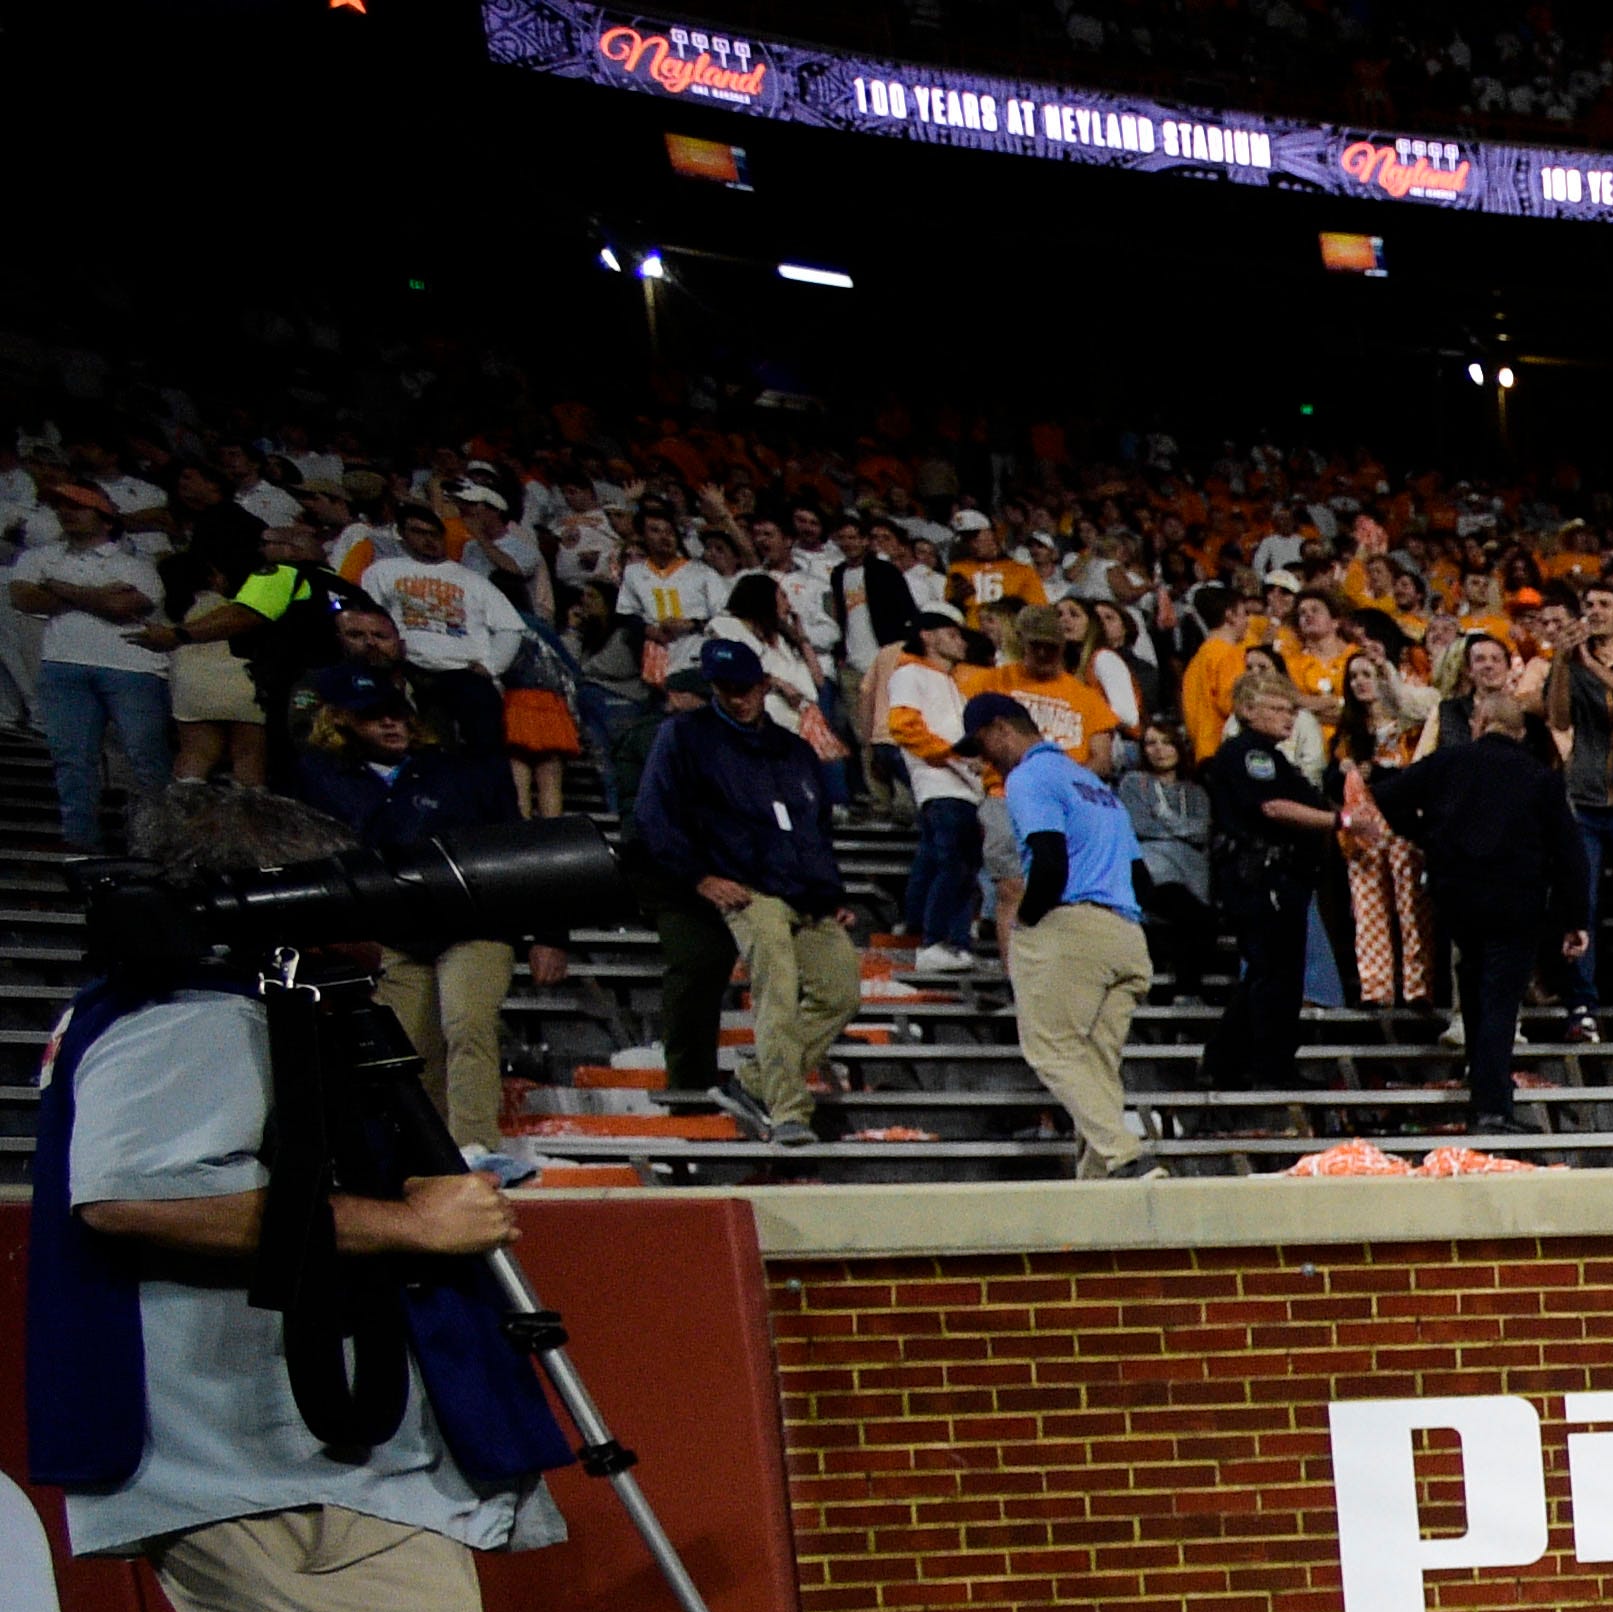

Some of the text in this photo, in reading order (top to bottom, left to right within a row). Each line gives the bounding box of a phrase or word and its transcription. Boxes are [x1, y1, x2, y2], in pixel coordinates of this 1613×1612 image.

[600, 26, 766, 93] Neyland
[854, 77, 1272, 168] 100 YEARS AT NEYLAND STADIUM
[1541, 167, 1581, 202] 100
[653, 588, 684, 623] 11
